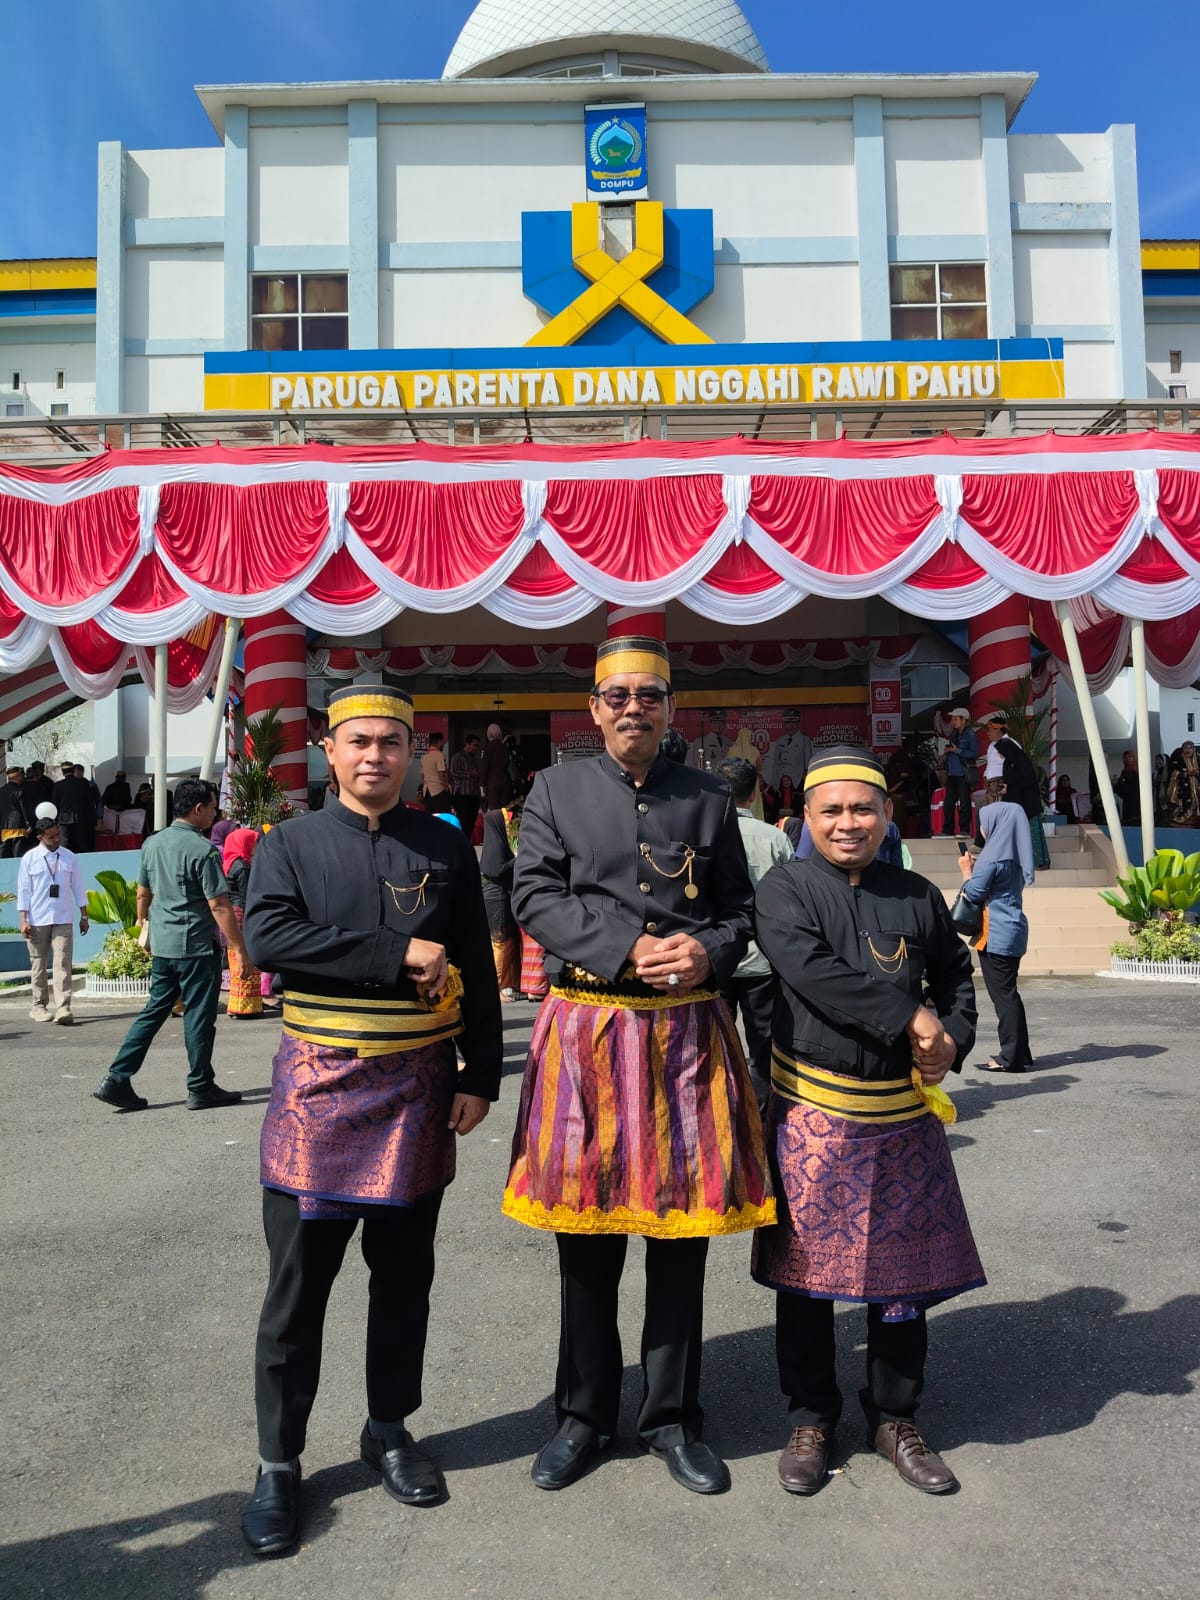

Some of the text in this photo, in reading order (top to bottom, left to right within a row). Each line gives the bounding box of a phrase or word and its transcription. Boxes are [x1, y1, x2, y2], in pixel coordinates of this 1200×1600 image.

[600, 179, 634, 188] DOMPU
[271, 363, 996, 409] PARUGA PARENTA DANA NGGAHI RAWI PAHU
[813, 734, 864, 743] INDONESIA
